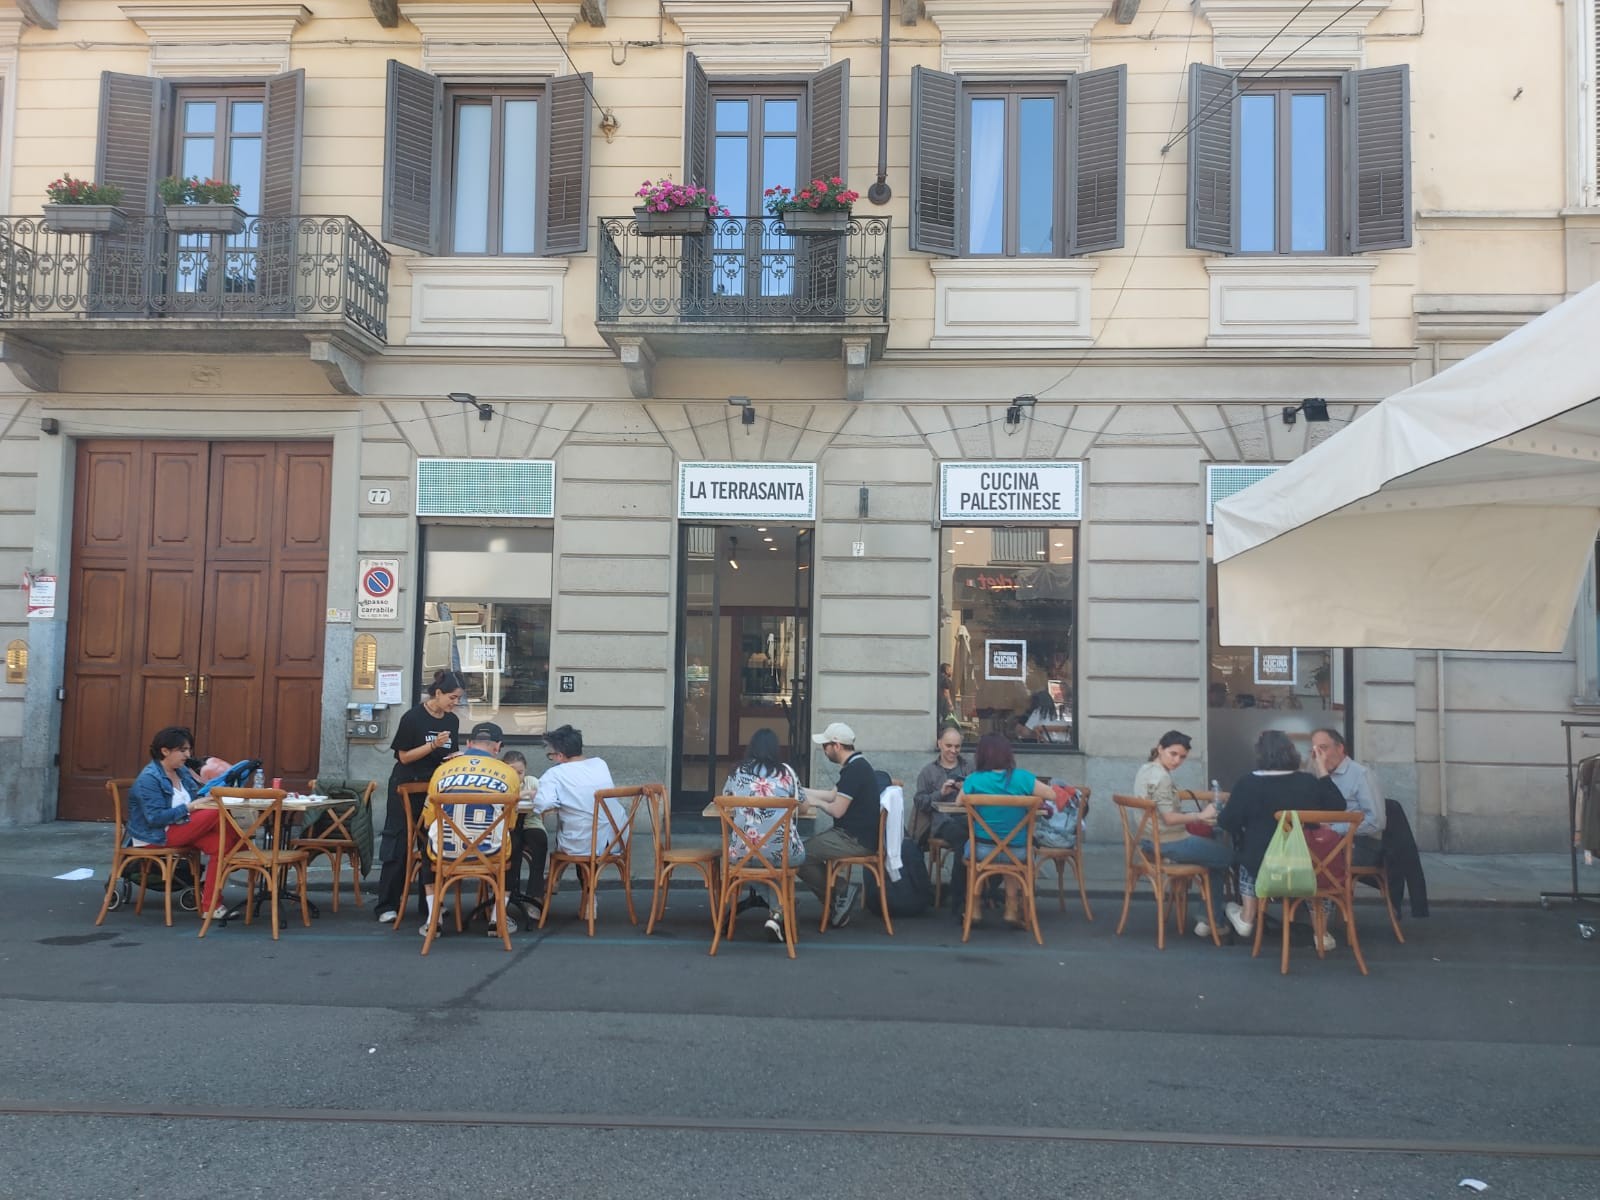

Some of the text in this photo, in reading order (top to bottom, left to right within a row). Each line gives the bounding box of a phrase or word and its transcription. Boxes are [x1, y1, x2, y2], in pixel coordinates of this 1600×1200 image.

[689, 481, 805, 501] LA TERRASANTA
[980, 472, 1039, 491] CUCINA
[371, 490, 387, 502] 77
[960, 492, 1062, 511] PALESTINESE
[994, 655, 1018, 664] CUCINA
